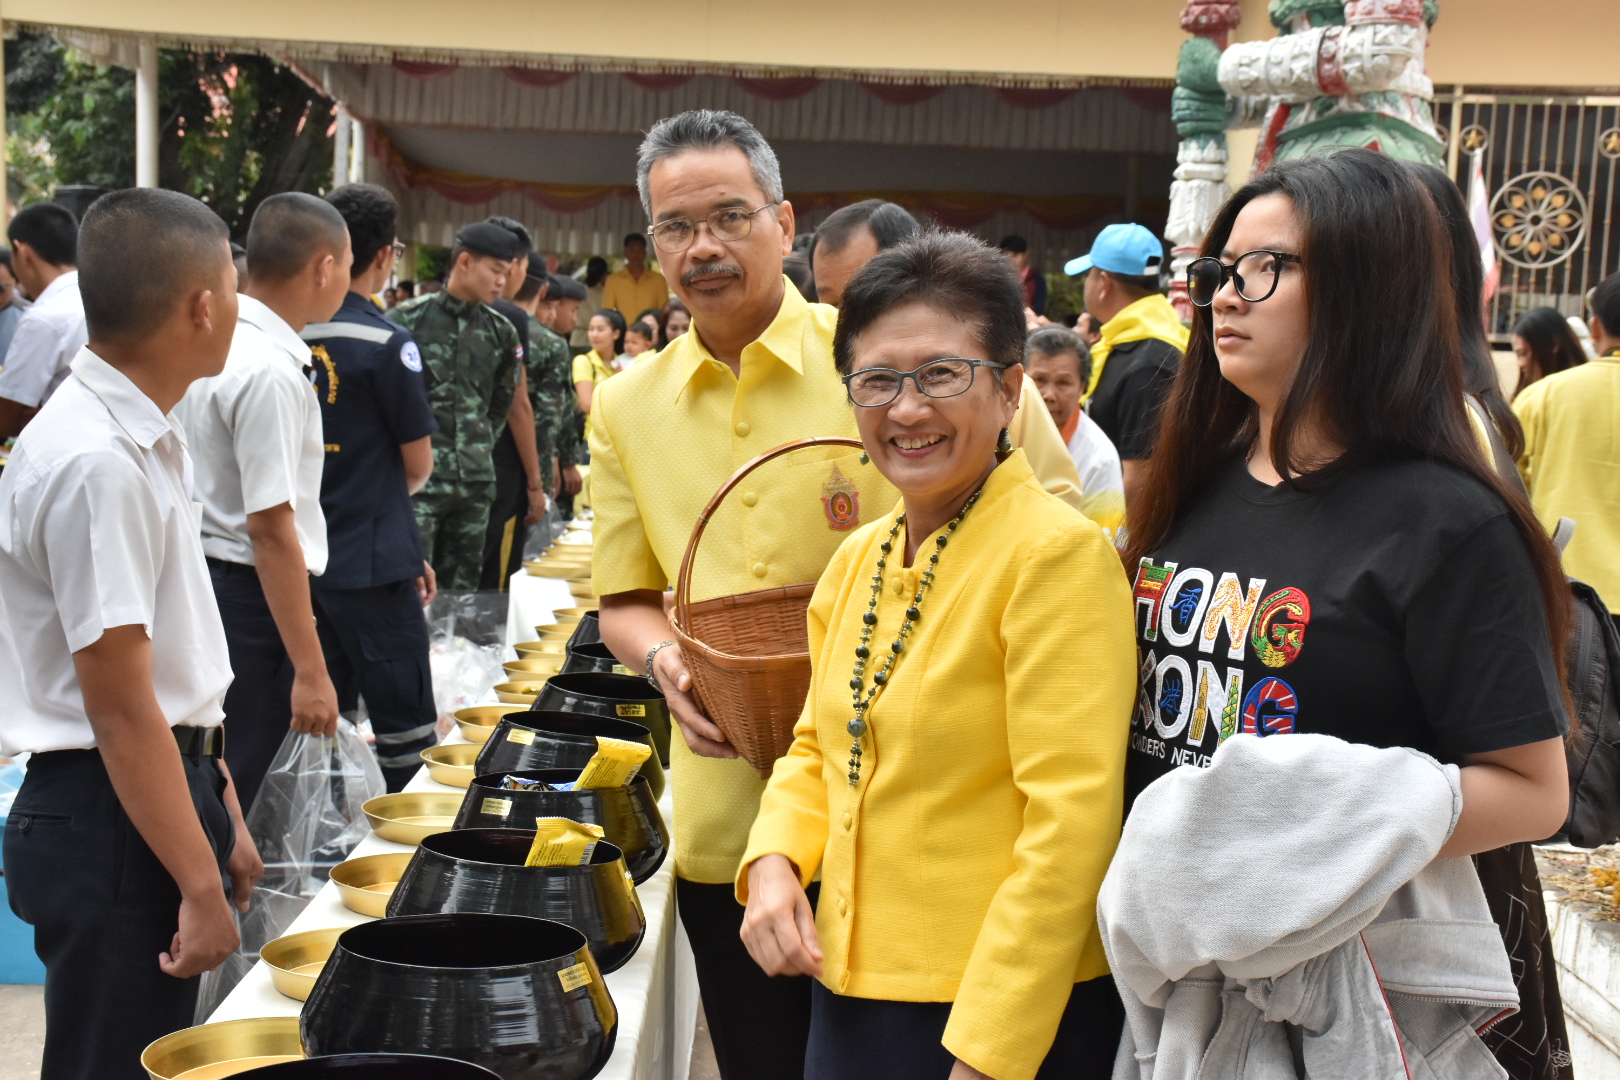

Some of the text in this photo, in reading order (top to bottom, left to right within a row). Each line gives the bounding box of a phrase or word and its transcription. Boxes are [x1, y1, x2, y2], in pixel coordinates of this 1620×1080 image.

[1132, 556, 1311, 668] HONG
[1169, 587, 1202, 626] 香
[1131, 646, 1298, 750] KONG
[1129, 730, 1166, 759] ONDERS
